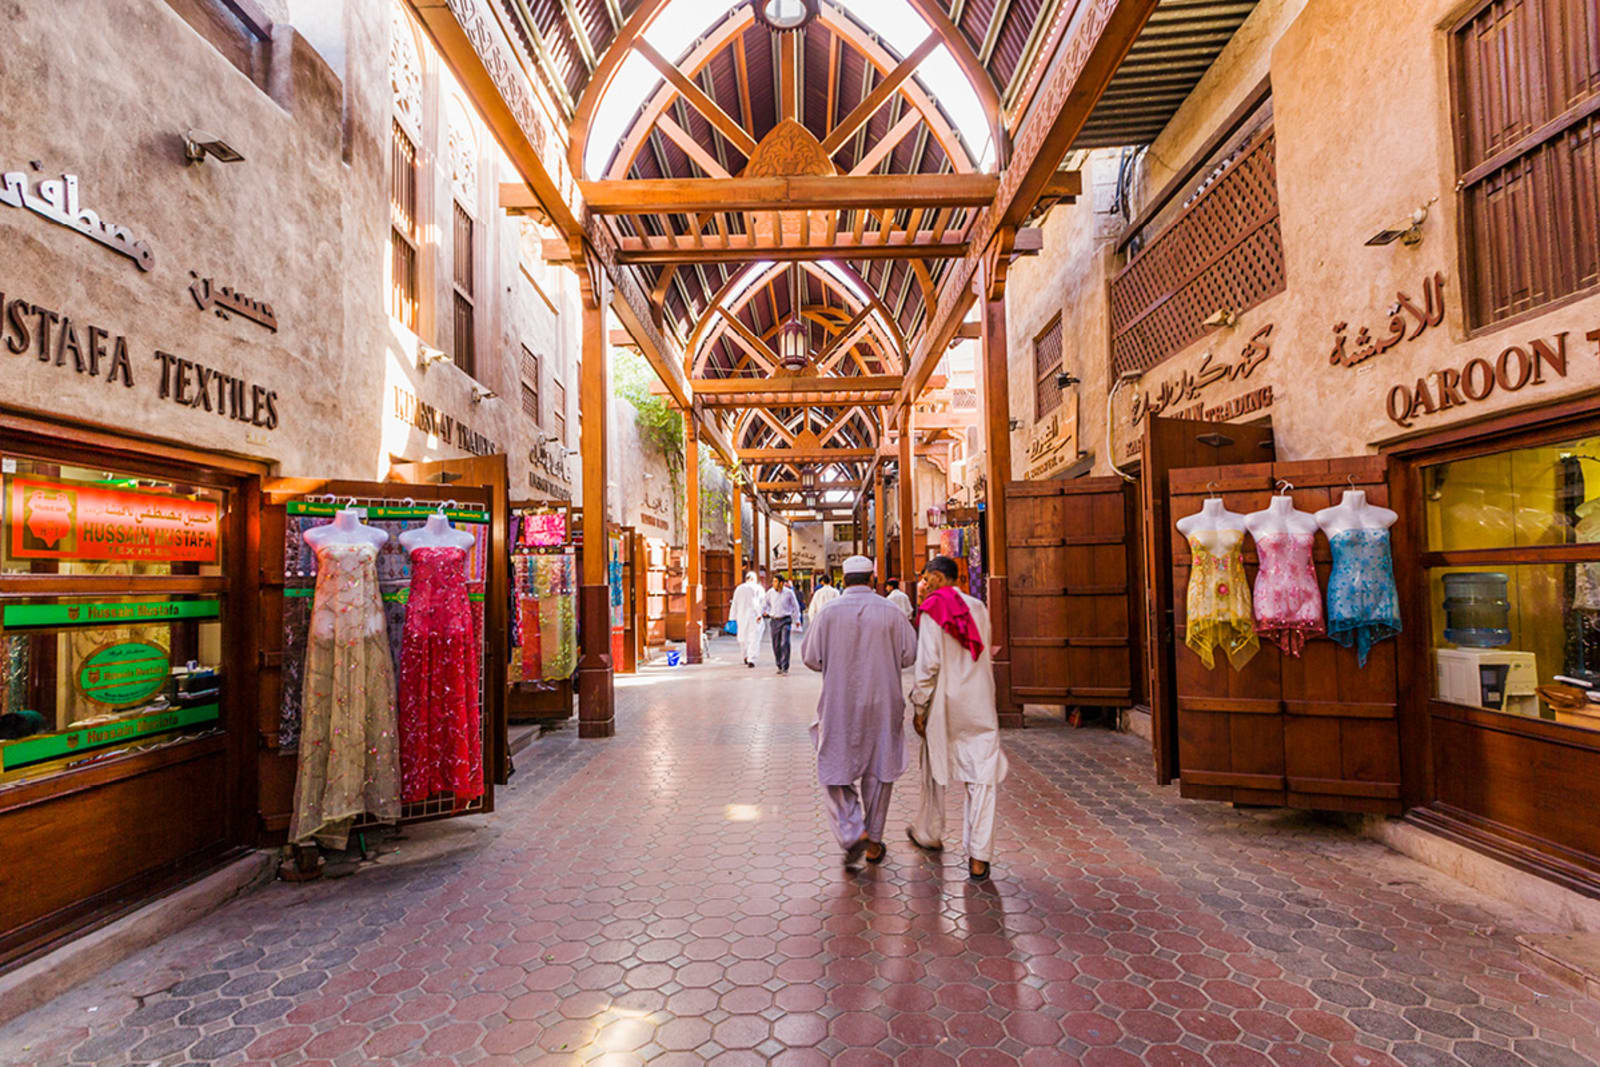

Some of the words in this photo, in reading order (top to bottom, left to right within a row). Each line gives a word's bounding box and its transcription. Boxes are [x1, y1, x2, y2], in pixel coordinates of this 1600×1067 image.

[0, 292, 134, 387] STAFA
[155, 350, 278, 430] TEXTILES
[1386, 331, 1569, 427] QAROON
[1205, 385, 1273, 422] TRADING
[83, 521, 149, 545] HUSSAIN
[154, 527, 212, 548] MUSTAFA
[88, 605, 134, 619] Hussain
[138, 603, 180, 618] Mustafa
[87, 724, 134, 744] Hussain
